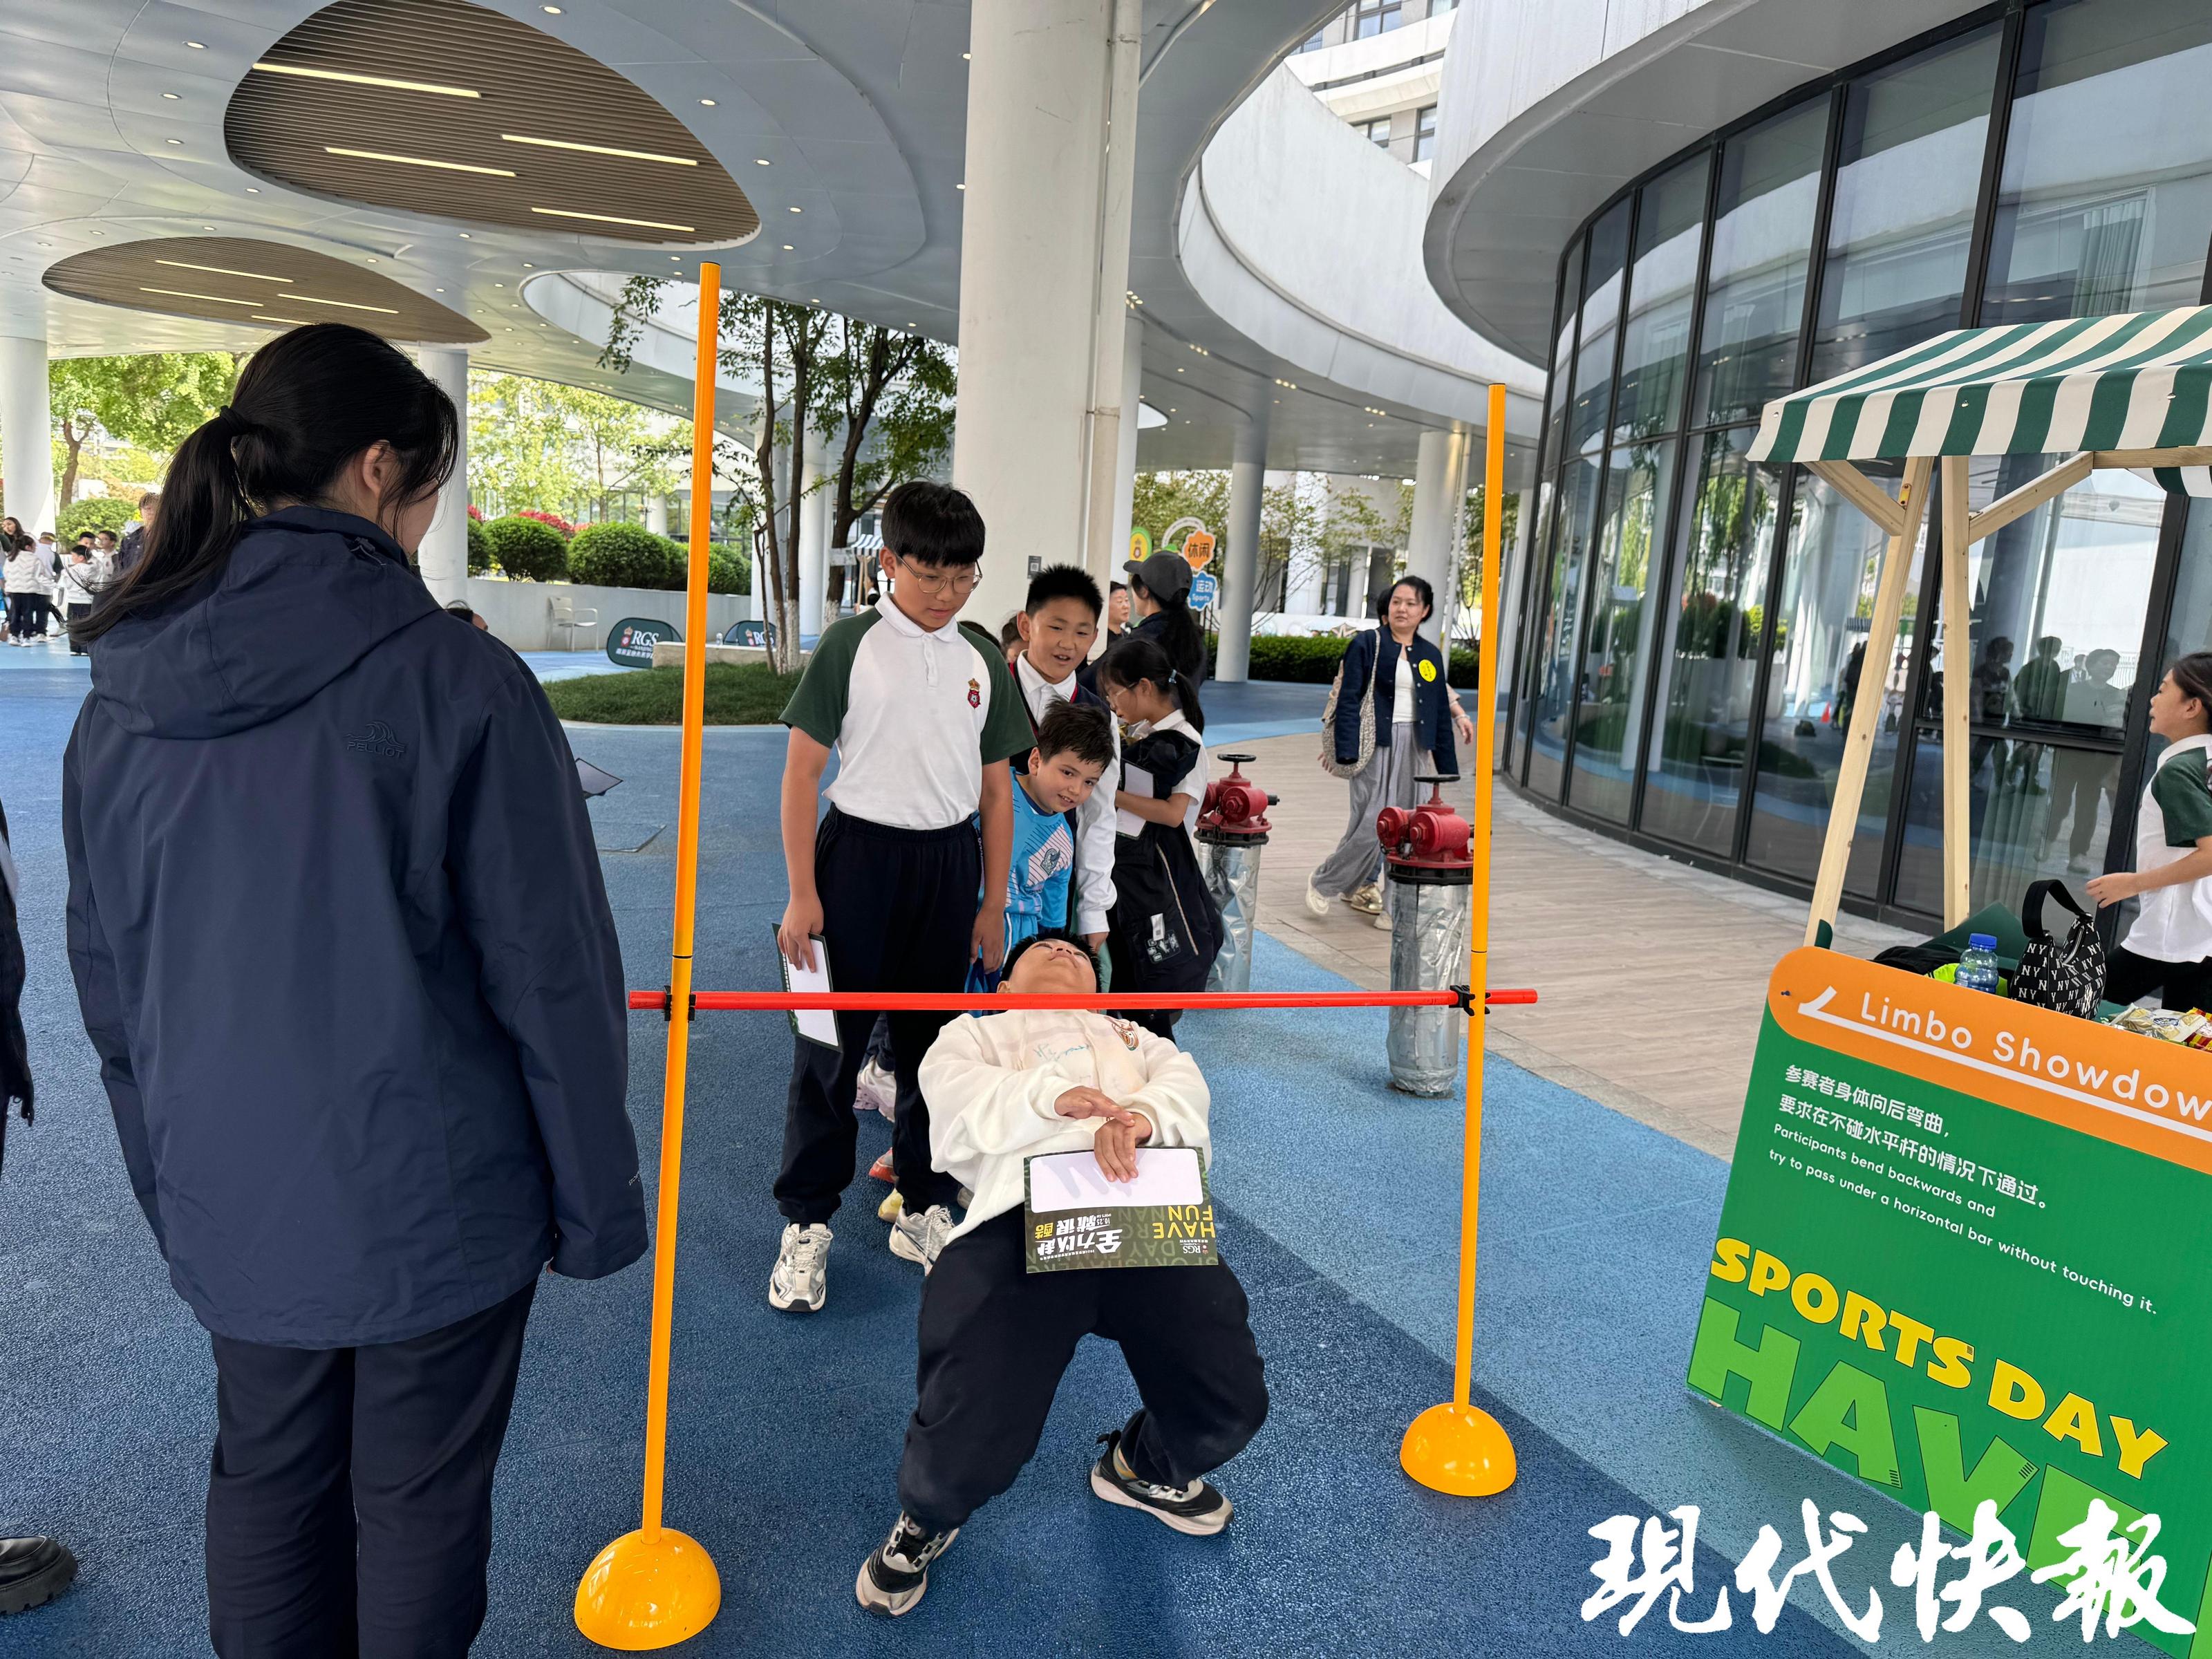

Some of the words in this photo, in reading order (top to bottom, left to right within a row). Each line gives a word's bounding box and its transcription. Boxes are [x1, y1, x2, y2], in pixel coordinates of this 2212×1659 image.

[1188, 543, 1210, 558] 休闲
[1196, 581, 1213, 593] 运动
[1192, 593, 1210, 602] Sports
[630, 630, 659, 646] RGS
[347, 741, 404, 758] PELLIOT
[2027, 943, 2047, 955] NY
[2021, 965, 2041, 977] NY
[2018, 988, 2036, 1000] NY
[1860, 991, 1971, 1048] Limbo
[1779, 1094, 2045, 1208] 要求在不碰水平杆的情况下通过。
[1774, 1123, 1846, 1160] Participants
[1850, 1152, 1884, 1174] bend
[1888, 1166, 1962, 1205] backwards
[1967, 1200, 1996, 1217] and
[1168, 1205, 1213, 1221] FUN
[1152, 1221, 1216, 1239] HAVE
[1770, 1149, 1786, 1165] try
[1790, 1157, 1802, 1170] to
[1806, 1165, 1835, 1183] pass
[1839, 1179, 1877, 1199] under
[1880, 1195, 1889, 1205] a
[1893, 1197, 1963, 1235] horizontal
[1968, 1226, 1993, 1246] bar
[1998, 1241, 2056, 1273] without
[2063, 1266, 2134, 1307] touching
[2139, 1297, 2156, 1314] it.
[1035, 1229, 1123, 1256] 全力以赴
[1183, 1245, 1201, 1254] RGS
[1712, 1238, 1974, 1388] SPORTS
[1989, 1360, 2167, 1478] DAY
